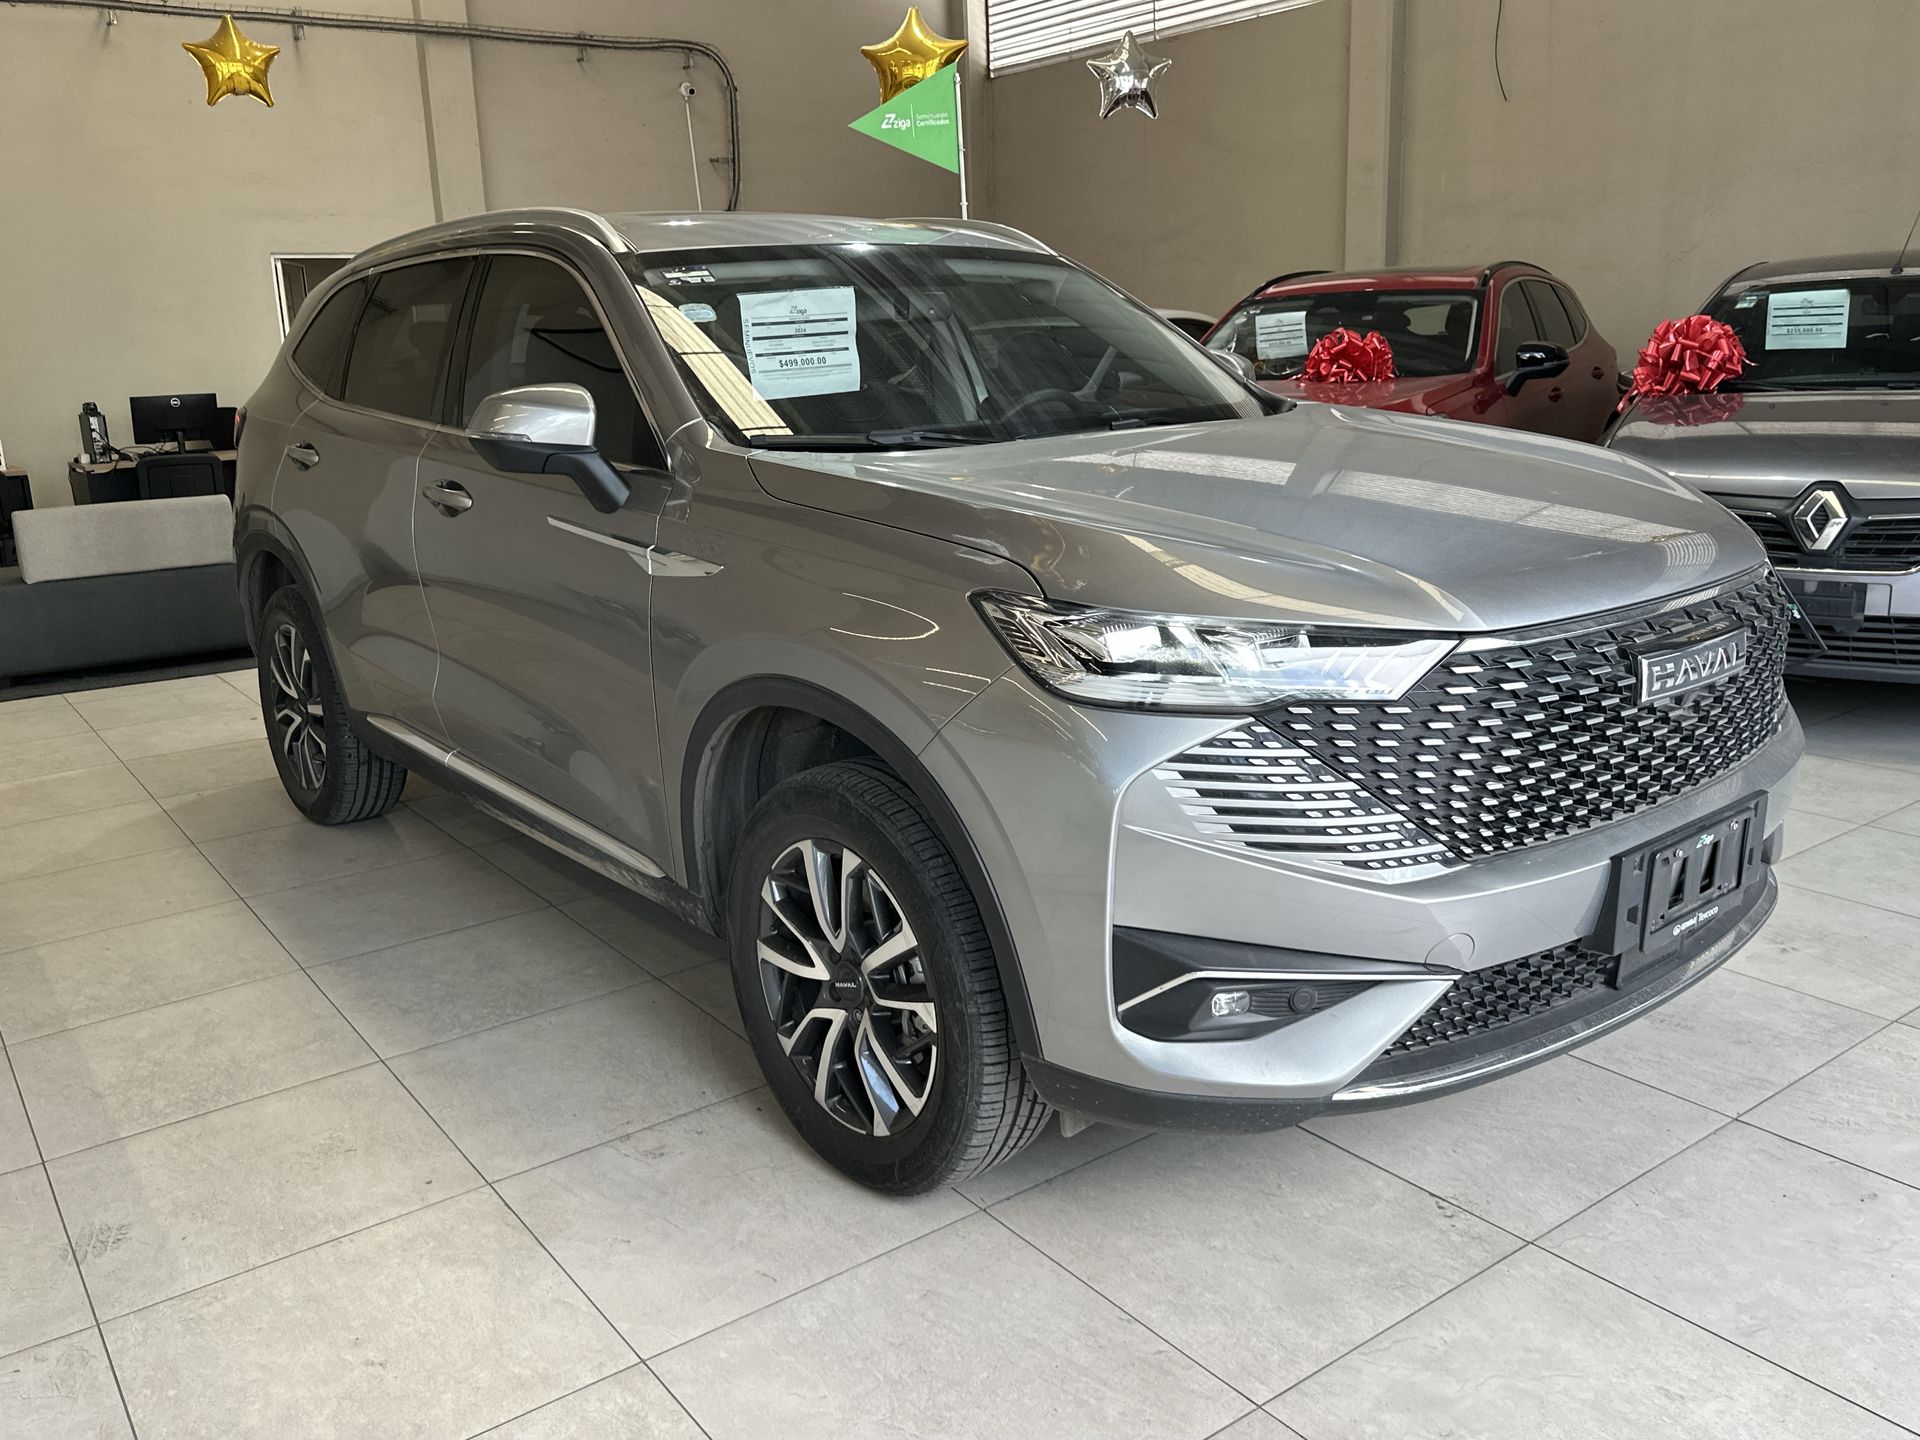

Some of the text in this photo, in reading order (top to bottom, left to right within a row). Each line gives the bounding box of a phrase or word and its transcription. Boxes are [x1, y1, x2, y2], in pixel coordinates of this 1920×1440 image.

[916, 119, 950, 127] Certificados
[743, 318, 756, 374] SEMINUEVOS
[778, 356, 827, 368] $499,000.00
[1651, 641, 1744, 692] HAVAL
